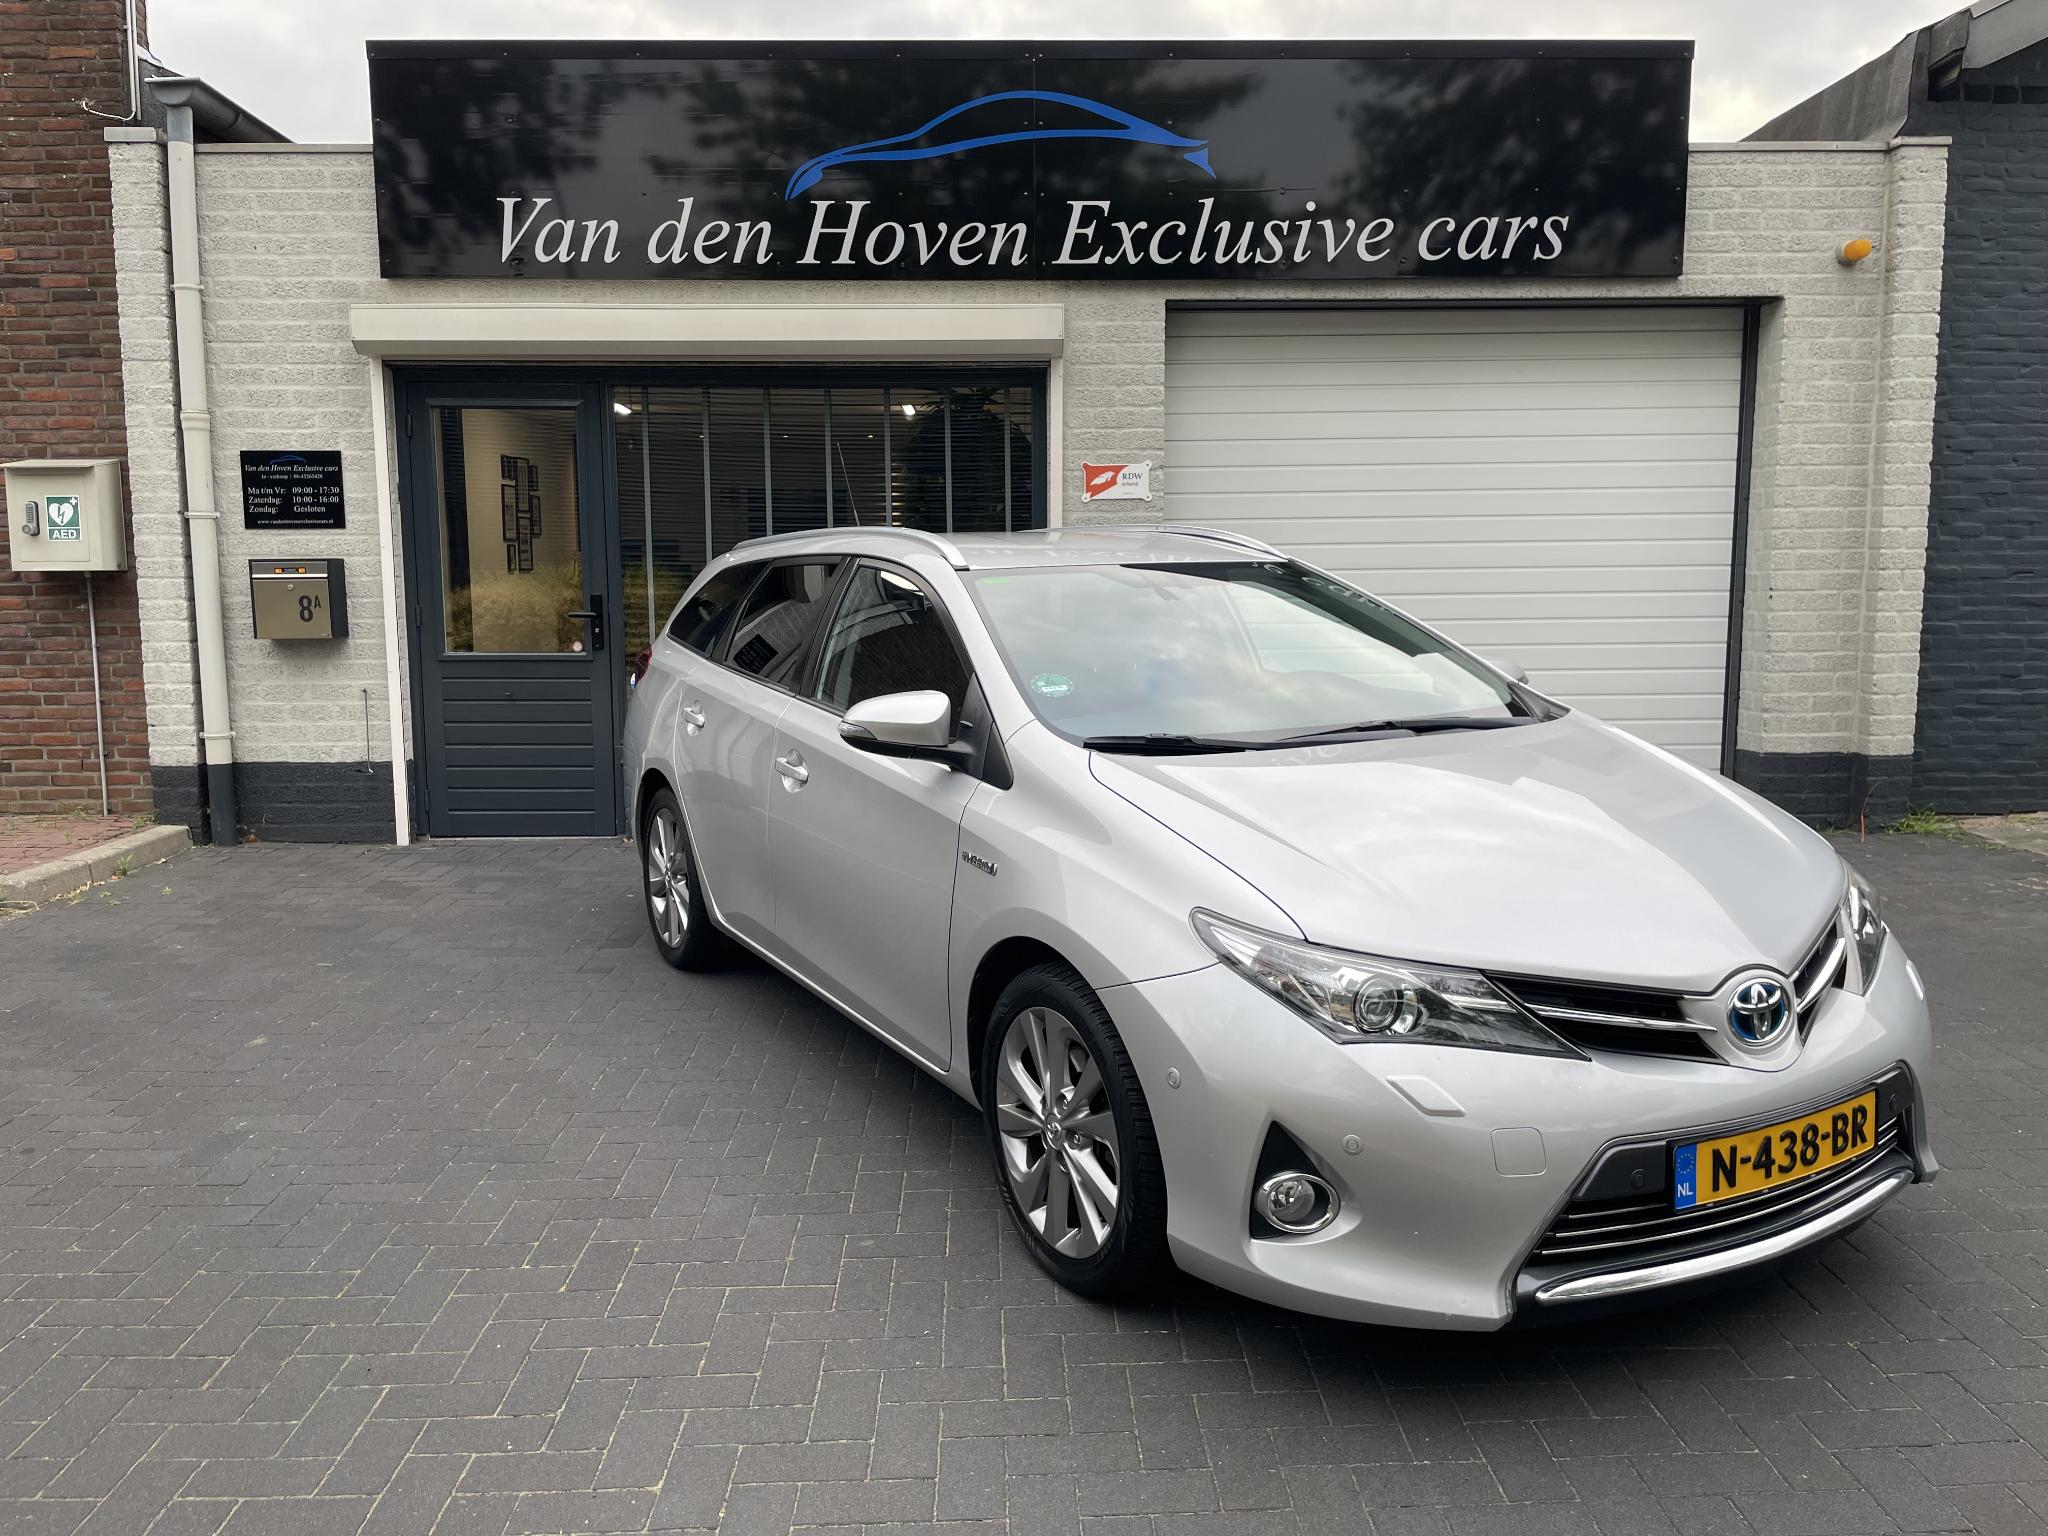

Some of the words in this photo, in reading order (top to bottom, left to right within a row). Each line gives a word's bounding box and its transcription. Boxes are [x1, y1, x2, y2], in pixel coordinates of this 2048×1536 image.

[496, 197, 621, 265] Van
[647, 197, 773, 265] den
[796, 200, 1029, 266] Hoven
[1051, 197, 1394, 265] Exclusive
[1417, 214, 1569, 262] cars
[1122, 472, 1143, 480] RDW
[261, 486, 273, 494] t/m
[292, 486, 313, 494] 09:00
[319, 486, 340, 494] 17:30
[248, 496, 283, 505] Zaterdag:
[249, 505, 279, 514] Zondag:
[293, 505, 326, 513] Gesloten
[53, 529, 77, 539] AED
[1677, 1182, 1693, 1198] NL
[1711, 1103, 1868, 1192] N-438-BR
